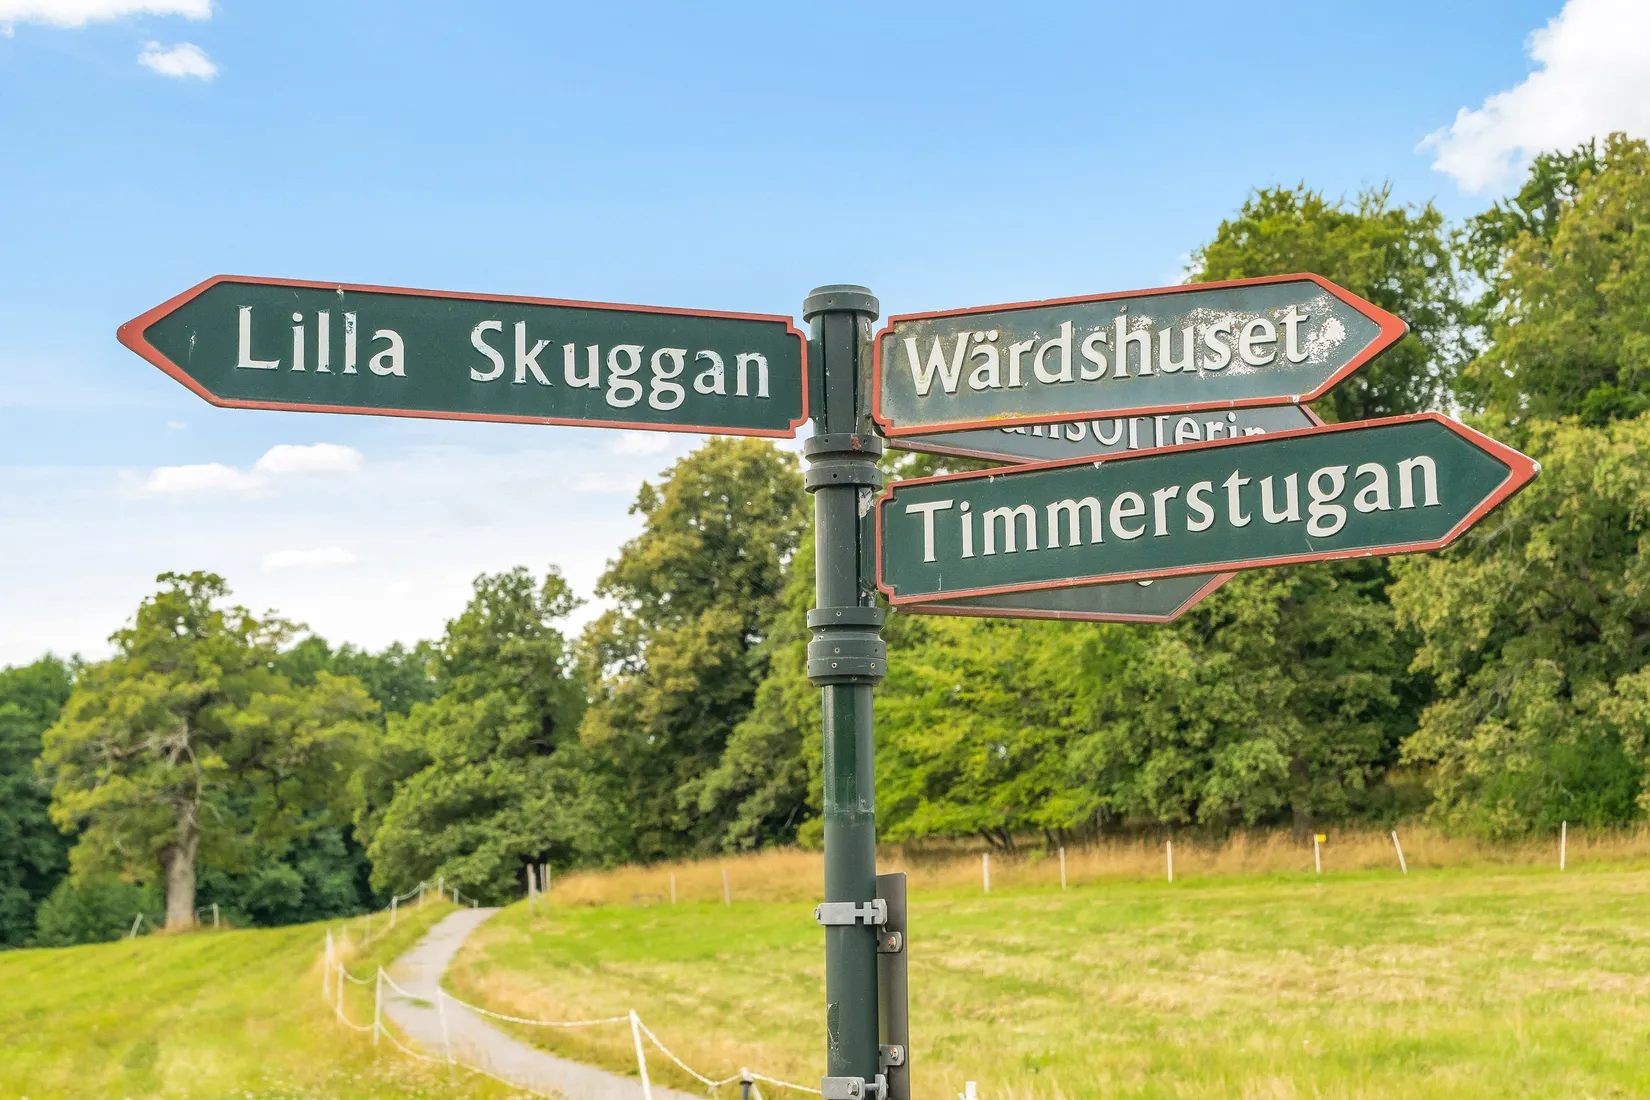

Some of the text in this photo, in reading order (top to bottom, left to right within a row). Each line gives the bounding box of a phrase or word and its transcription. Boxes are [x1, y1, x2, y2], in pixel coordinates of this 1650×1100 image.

[236, 305, 771, 411] Lilla Skuggan
[902, 305, 1311, 396] Wärdshuset
[905, 454, 1441, 563] Timmerstugan
